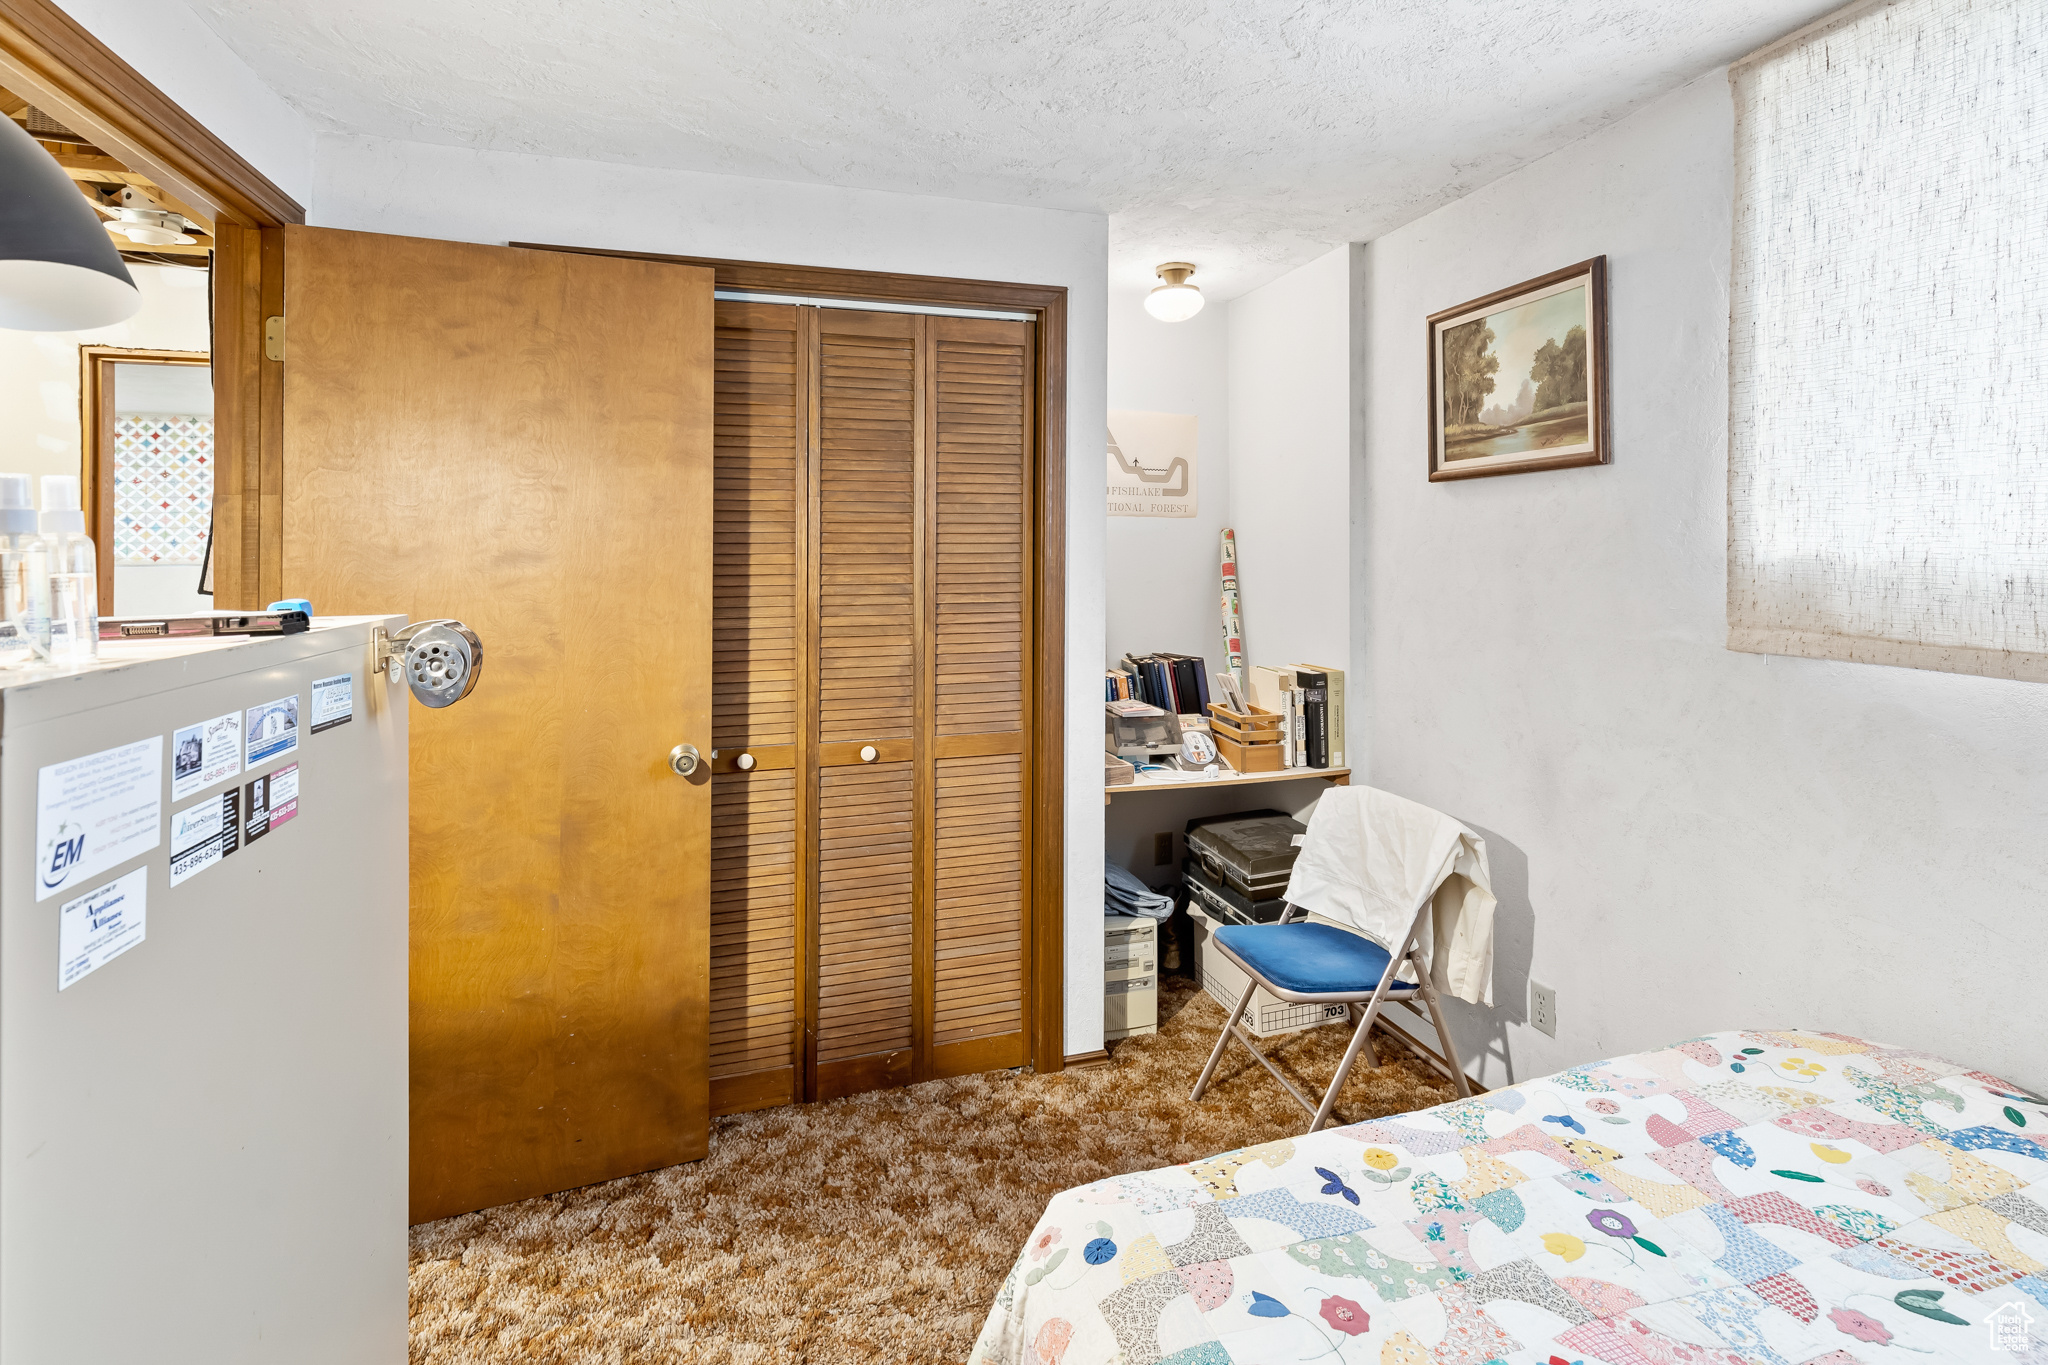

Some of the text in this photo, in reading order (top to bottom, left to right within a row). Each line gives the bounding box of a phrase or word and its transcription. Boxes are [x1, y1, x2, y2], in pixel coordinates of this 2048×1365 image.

[1111, 486, 1161, 497] FISHLAKE
[1150, 503, 1189, 513] FOREST
[206, 718, 224, 743] South
[224, 717, 239, 731] Fork
[84, 752, 117, 769] EMERGENCY
[118, 748, 132, 758] ALERT
[132, 743, 150, 754] SYSTEM
[50, 833, 86, 873] EM
[173, 843, 222, 876] 435-896-6264
[85, 894, 126, 919] Appliance
[90, 910, 123, 933] Alliance
[1324, 1005, 1344, 1017] 703
